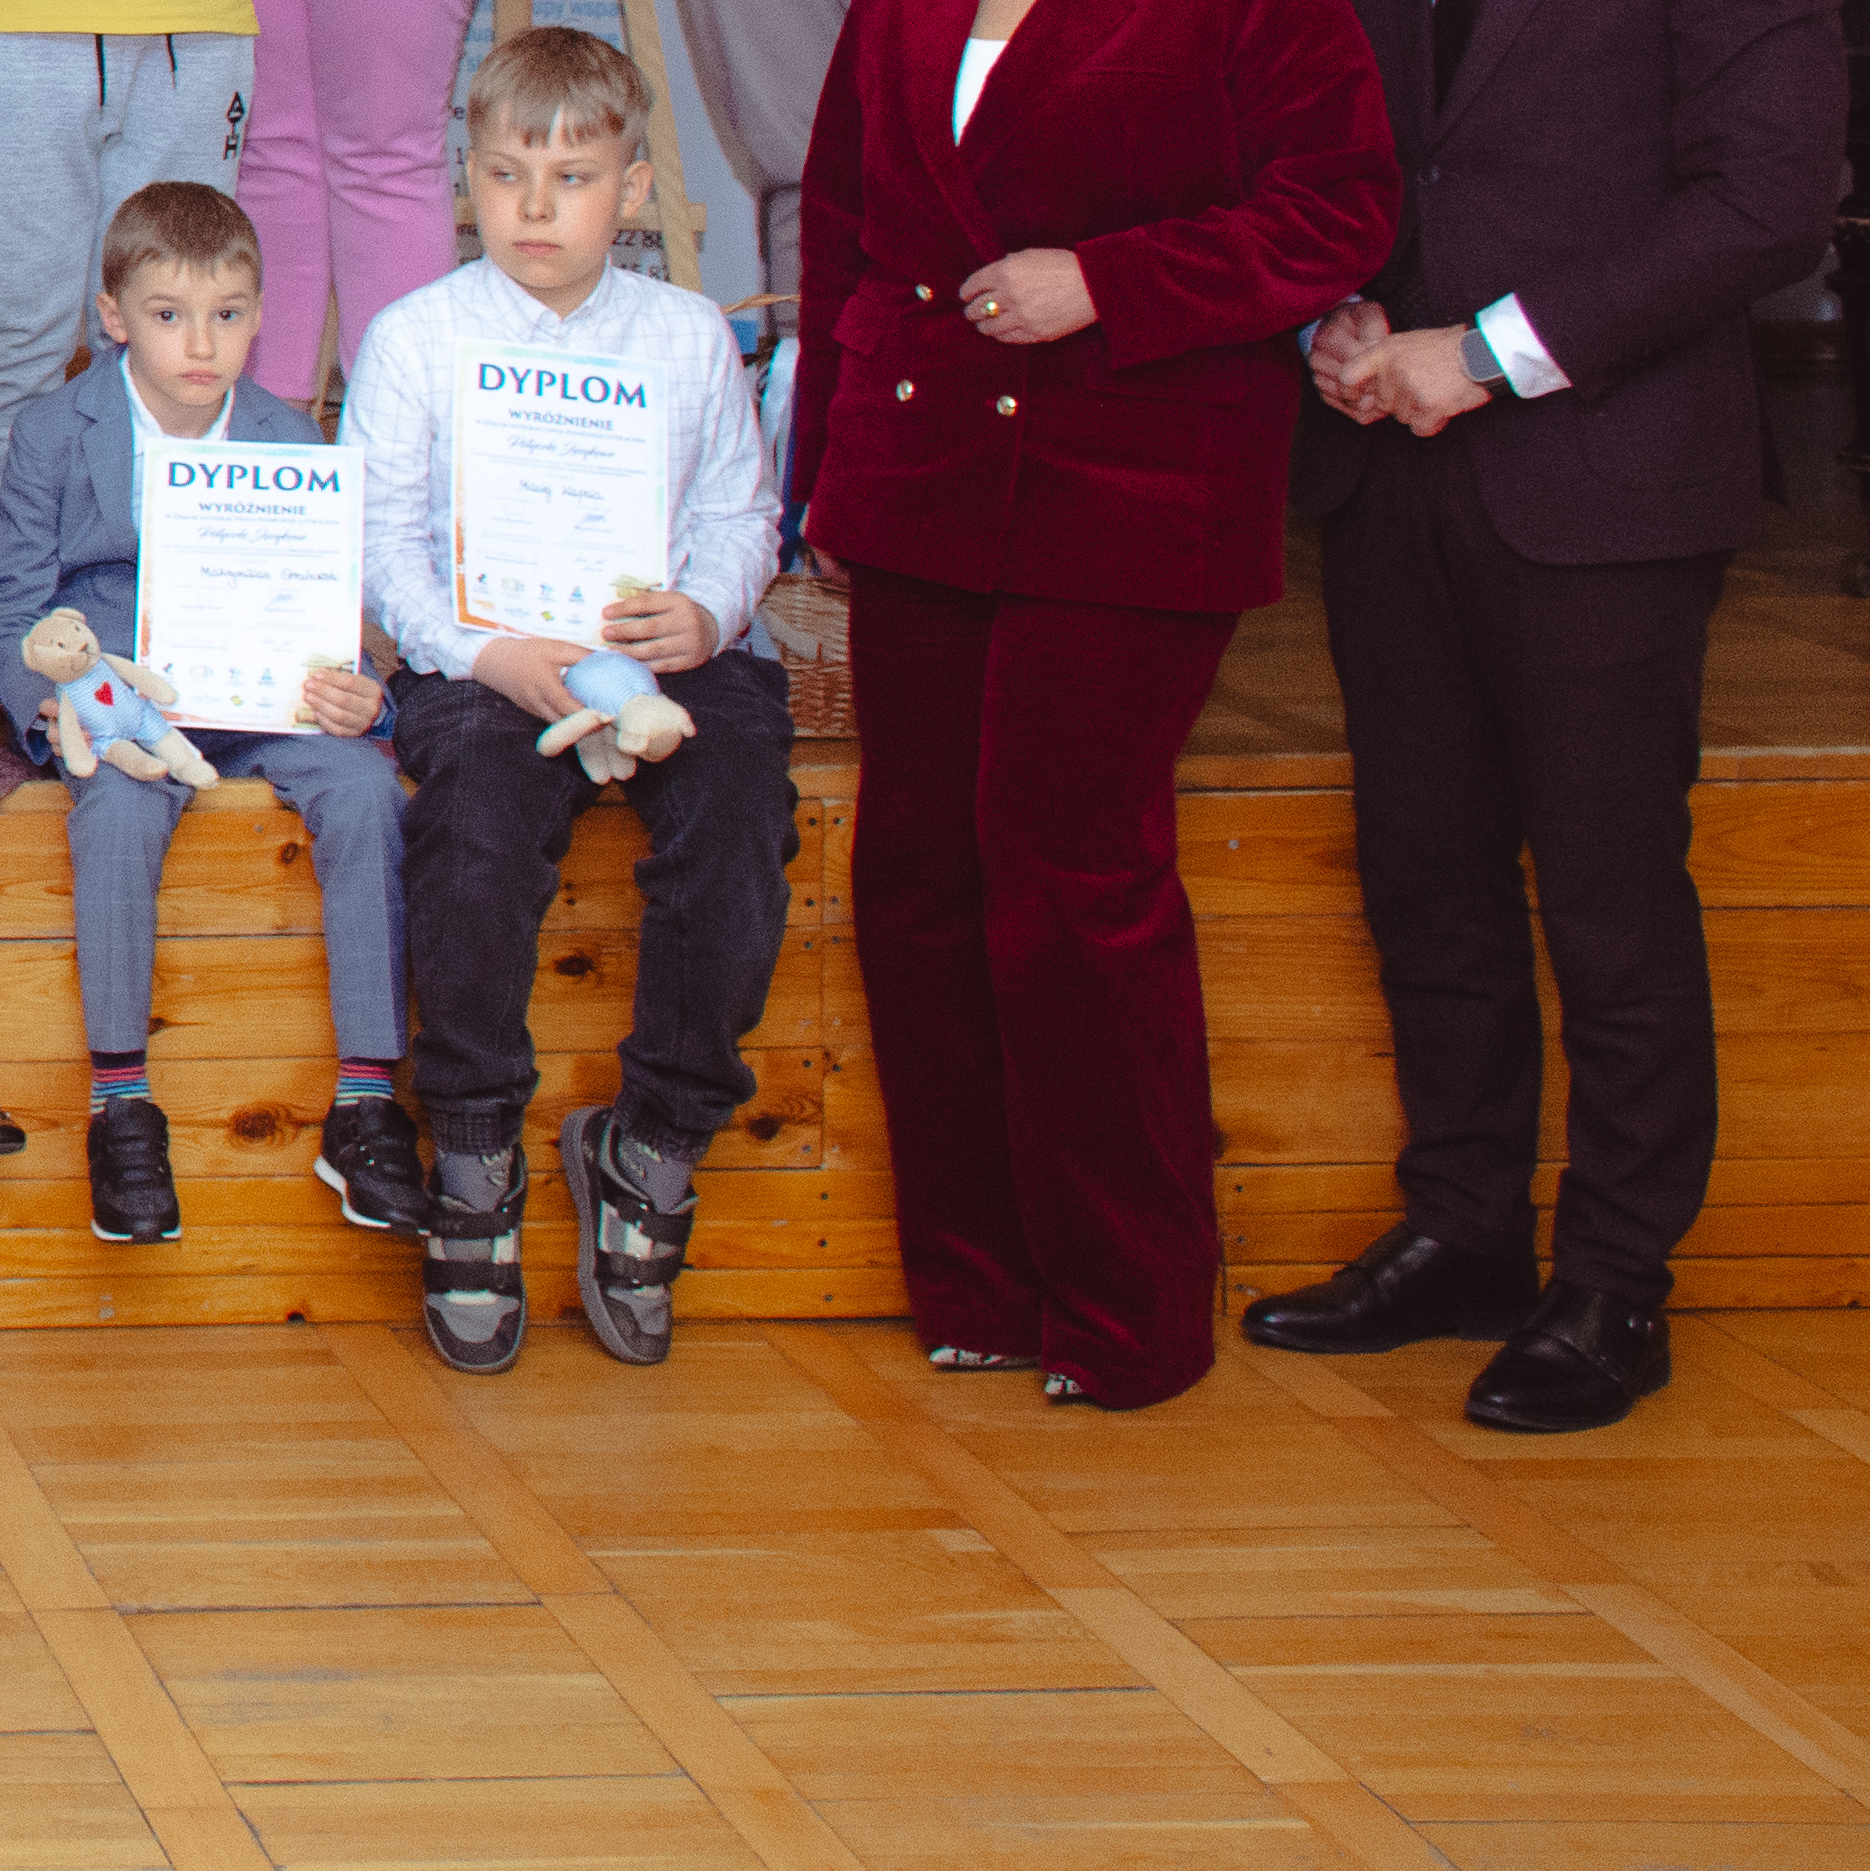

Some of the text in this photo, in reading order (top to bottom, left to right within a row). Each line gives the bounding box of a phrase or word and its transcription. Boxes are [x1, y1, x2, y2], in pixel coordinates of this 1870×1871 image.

[478, 362, 647, 409] DYPLOM
[508, 408, 614, 431] WYRÓŻNIENIE
[168, 462, 341, 492] DYPLOM
[198, 501, 307, 516] WYRÓŻNIENIE
